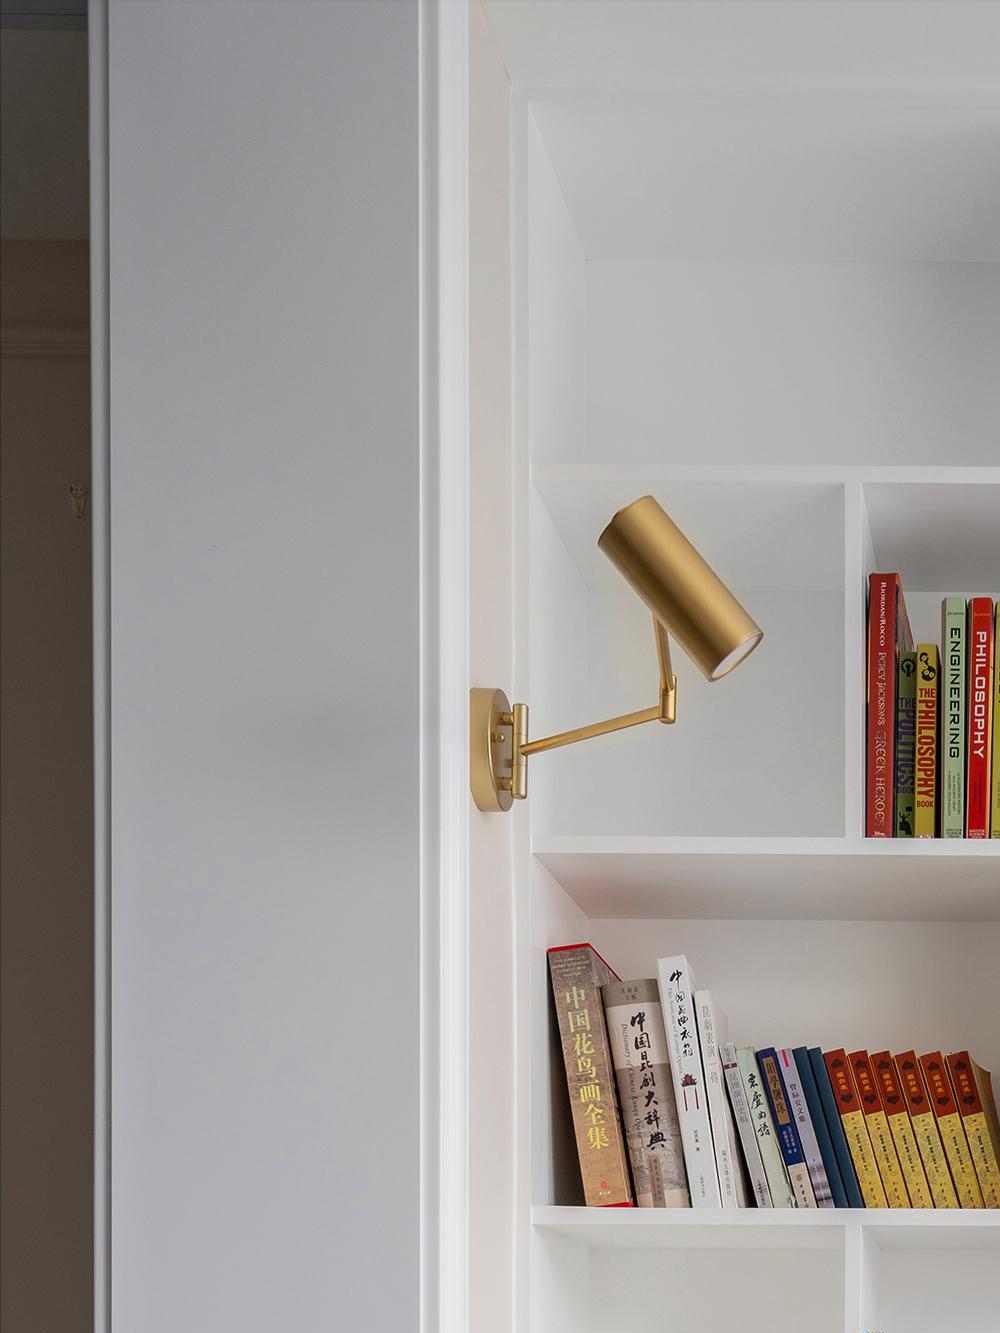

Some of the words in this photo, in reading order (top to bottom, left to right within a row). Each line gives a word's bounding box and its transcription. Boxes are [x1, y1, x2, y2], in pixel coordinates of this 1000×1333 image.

[918, 687, 936, 698] THE
[949, 627, 961, 759] ENGINEERING
[973, 631, 987, 758] PHILOSOPHY
[917, 699, 936, 799] PHILOSOPHY
[917, 800, 934, 808] BOOK
[566, 985, 609, 1150] 中国花鸟画全集
[621, 1023, 631, 1060] Dictionary
[628, 1067, 636, 1094] Chinese
